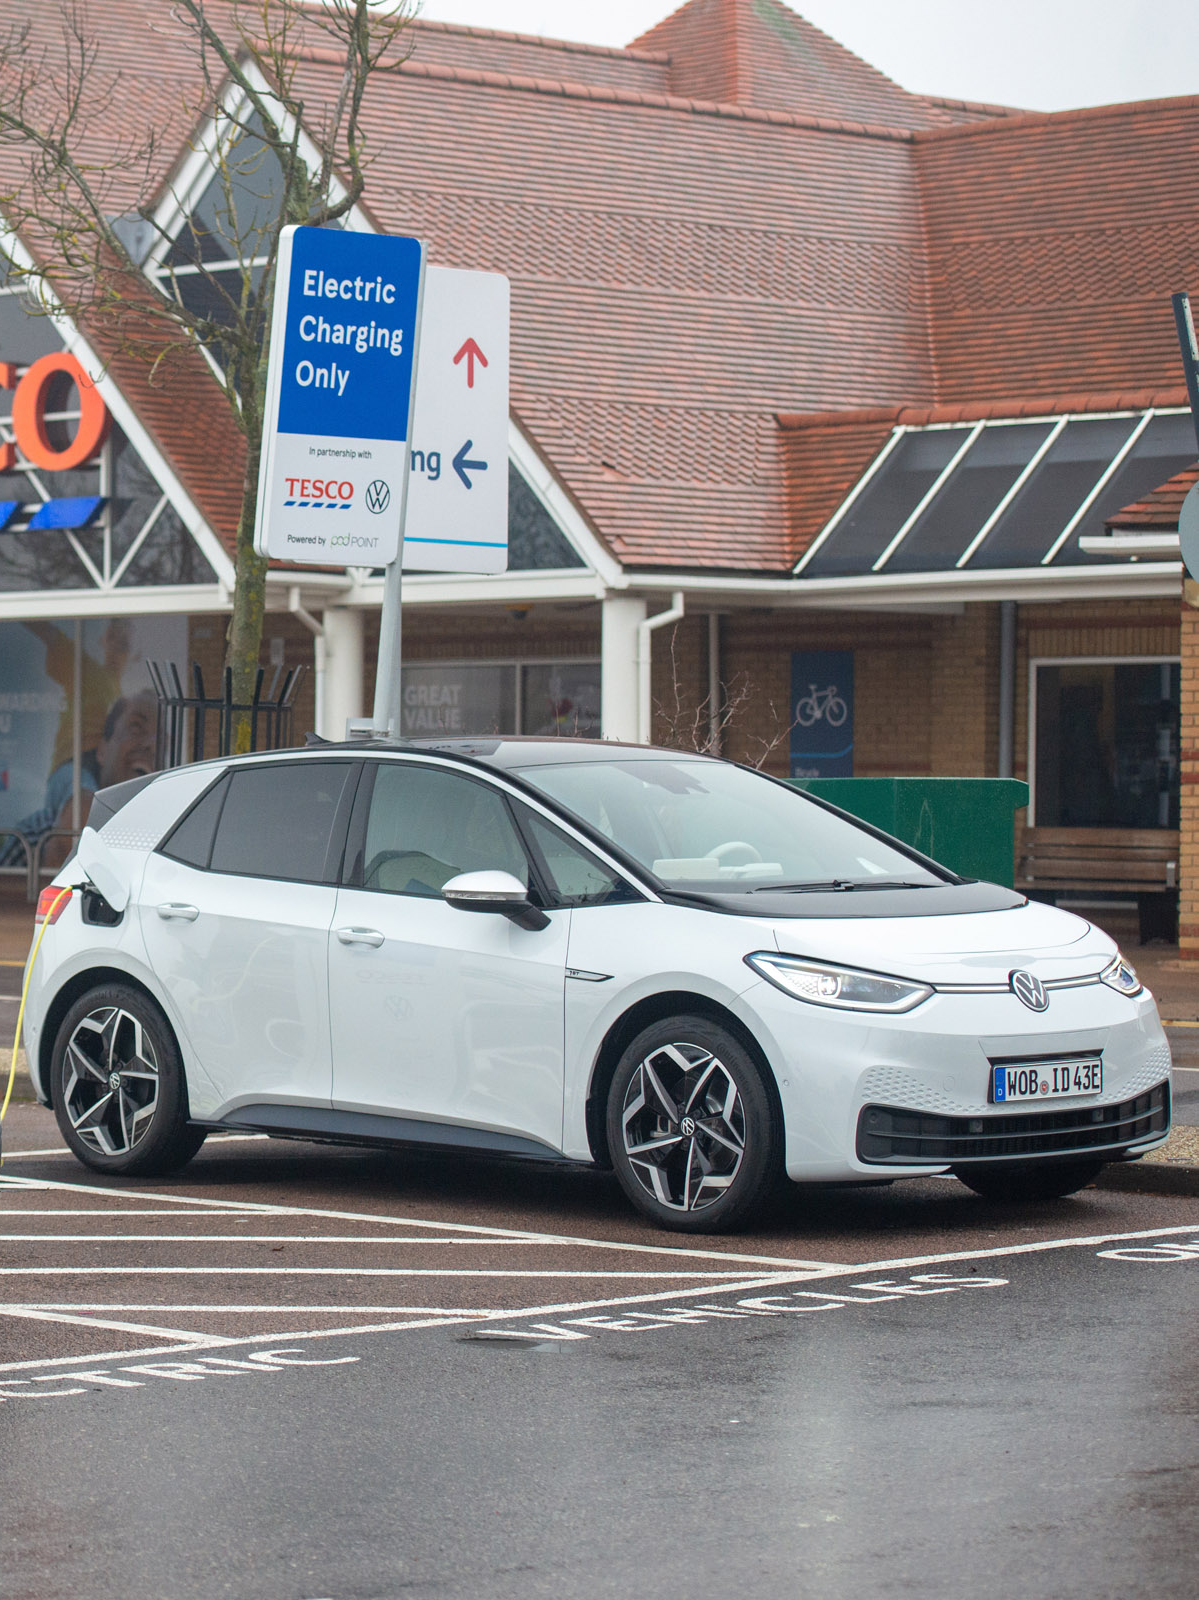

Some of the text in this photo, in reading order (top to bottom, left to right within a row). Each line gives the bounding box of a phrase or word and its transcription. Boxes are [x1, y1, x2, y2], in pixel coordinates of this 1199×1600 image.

[303, 269, 396, 304] Electric
[299, 315, 403, 357] Charging
[295, 360, 350, 397] Only
[308, 447, 372, 460] In partnership with
[285, 477, 354, 500] TESCO
[287, 532, 380, 549] Powered by pod POINT
[404, 685, 462, 706] GREAT
[1007, 1064, 1100, 1097] WOB ID 43E
[477, 1272, 1010, 1342] VEHICLES
